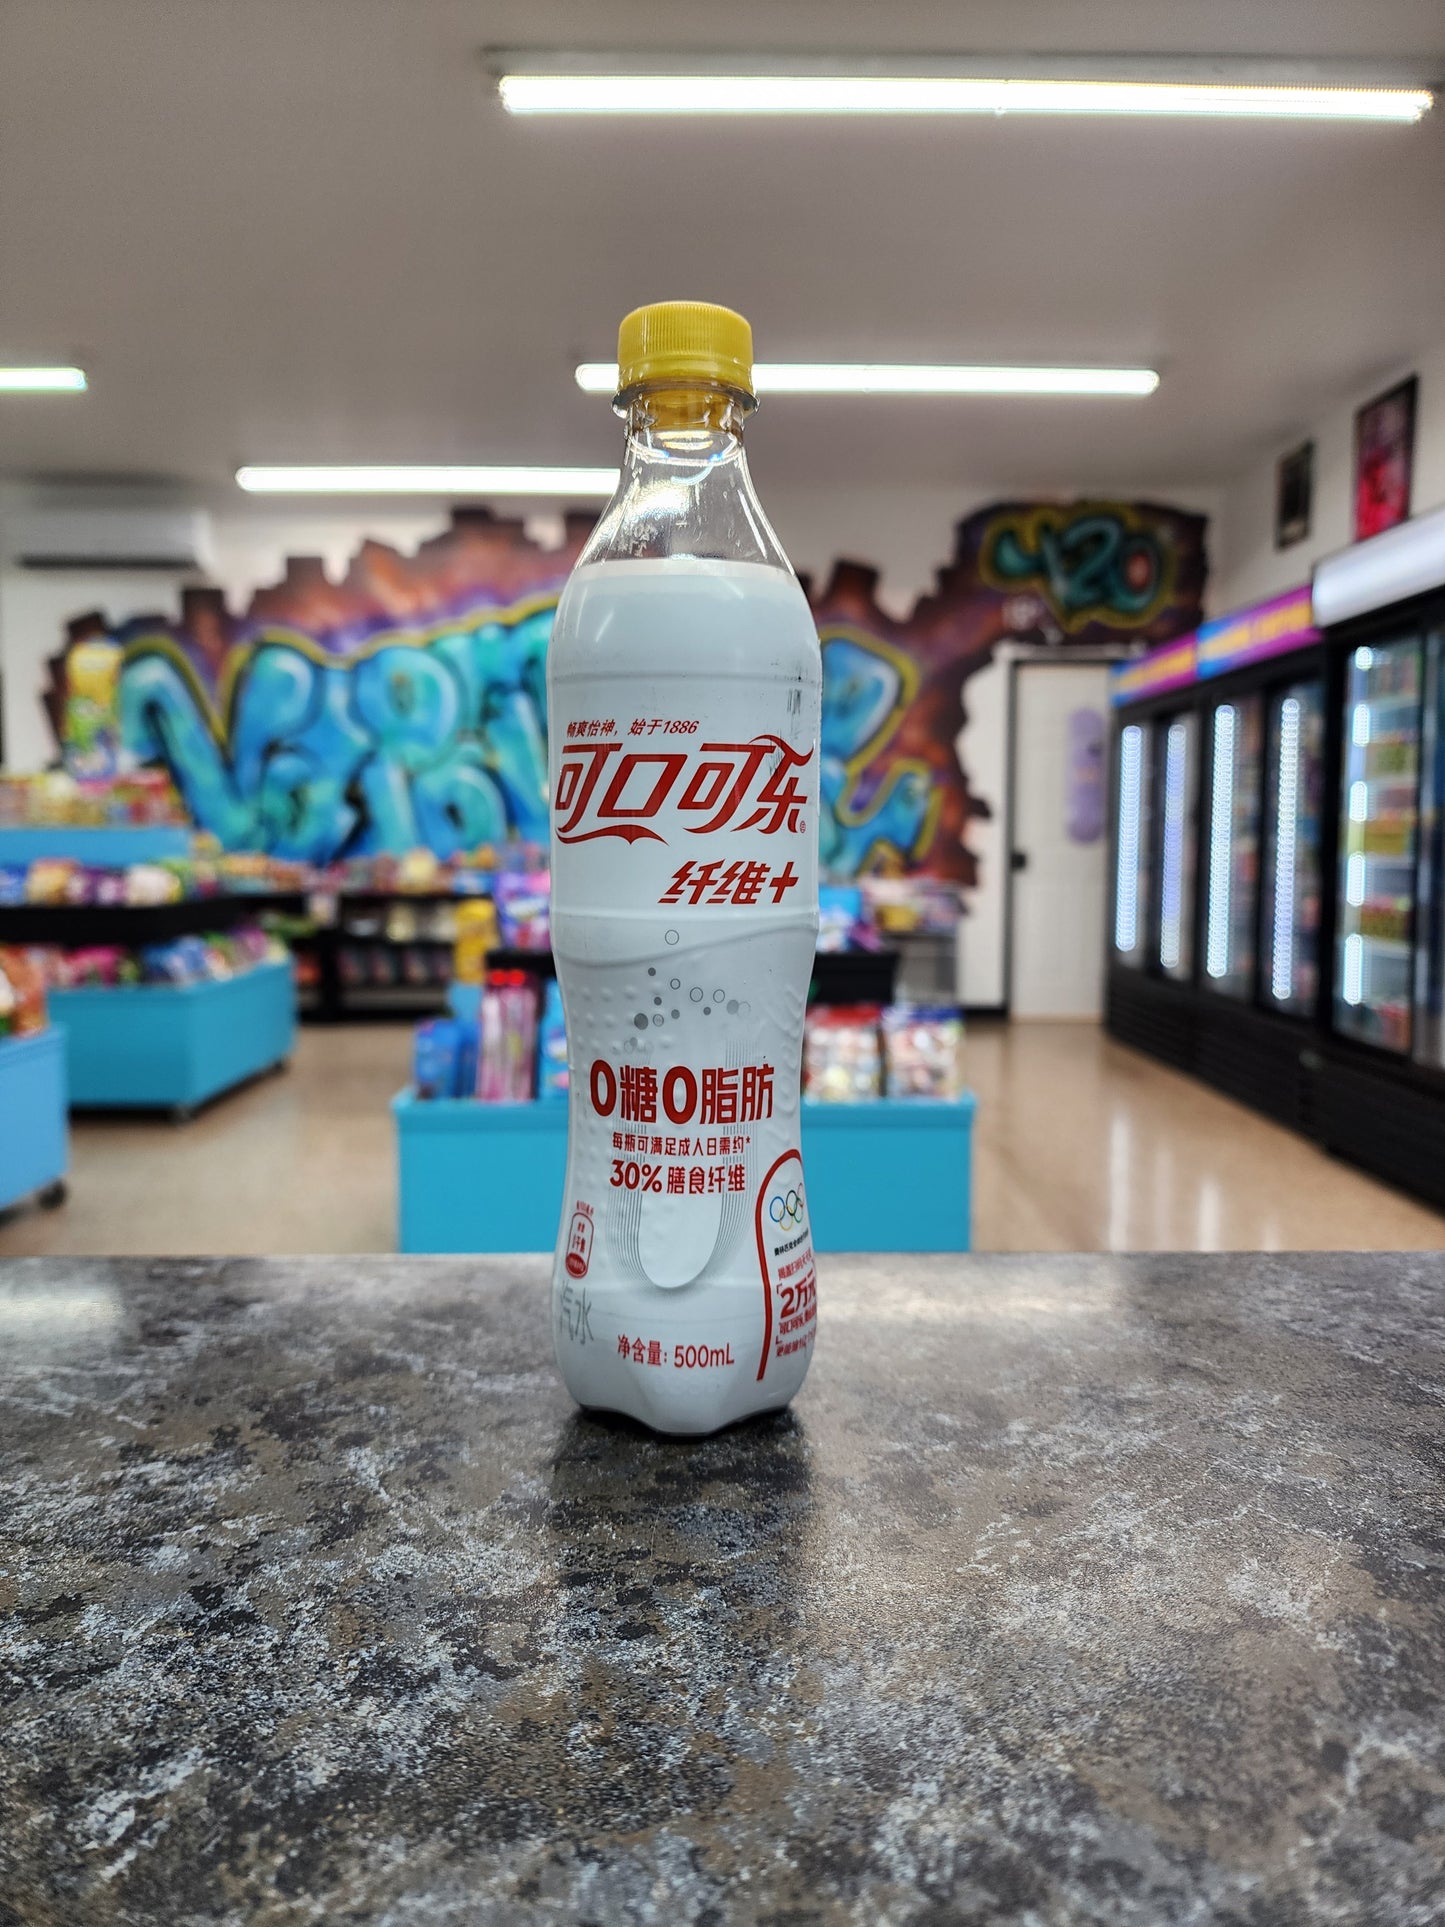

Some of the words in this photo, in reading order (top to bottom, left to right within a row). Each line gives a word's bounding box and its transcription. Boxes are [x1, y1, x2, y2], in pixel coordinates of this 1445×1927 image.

[554, 734, 815, 835] 可口可乐
[657, 858, 799, 905] 纤维+
[590, 1059, 775, 1125] 0糖0脂肪
[609, 1159, 746, 1194] 30%膳食纤维
